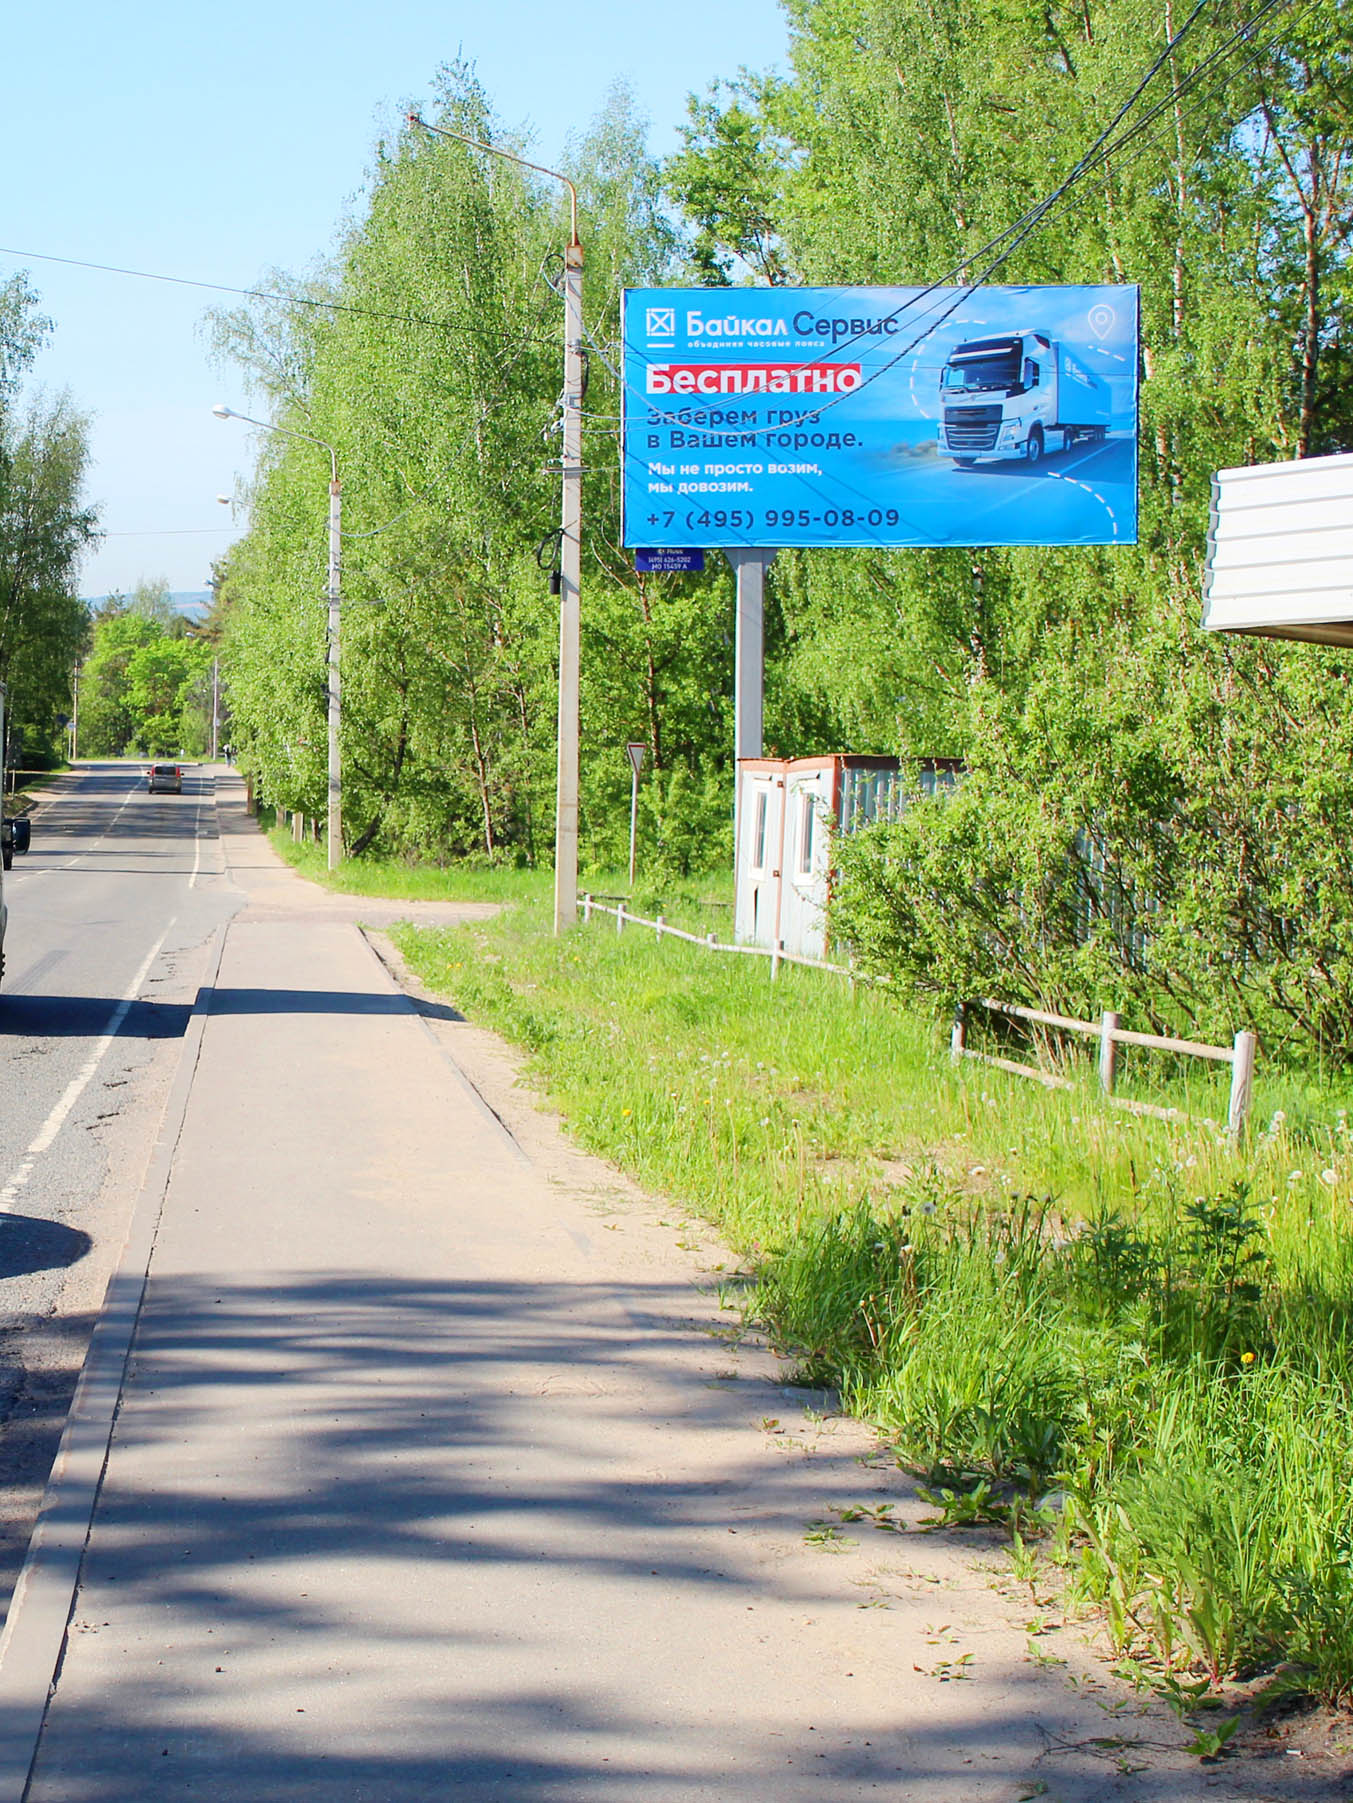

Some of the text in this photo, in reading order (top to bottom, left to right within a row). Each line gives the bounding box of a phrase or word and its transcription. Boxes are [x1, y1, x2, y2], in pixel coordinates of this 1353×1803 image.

[686, 310, 900, 344] Байкал Сервис
[646, 363, 862, 394] Бесплатно
[647, 406, 821, 429] Заберем груз
[647, 430, 863, 450] в Вашем городе.
[648, 462, 823, 477] Мы не просто возим,
[648, 481, 753, 495] мы довозим.
[647, 508, 900, 530] +7 (495) 995-08-09
